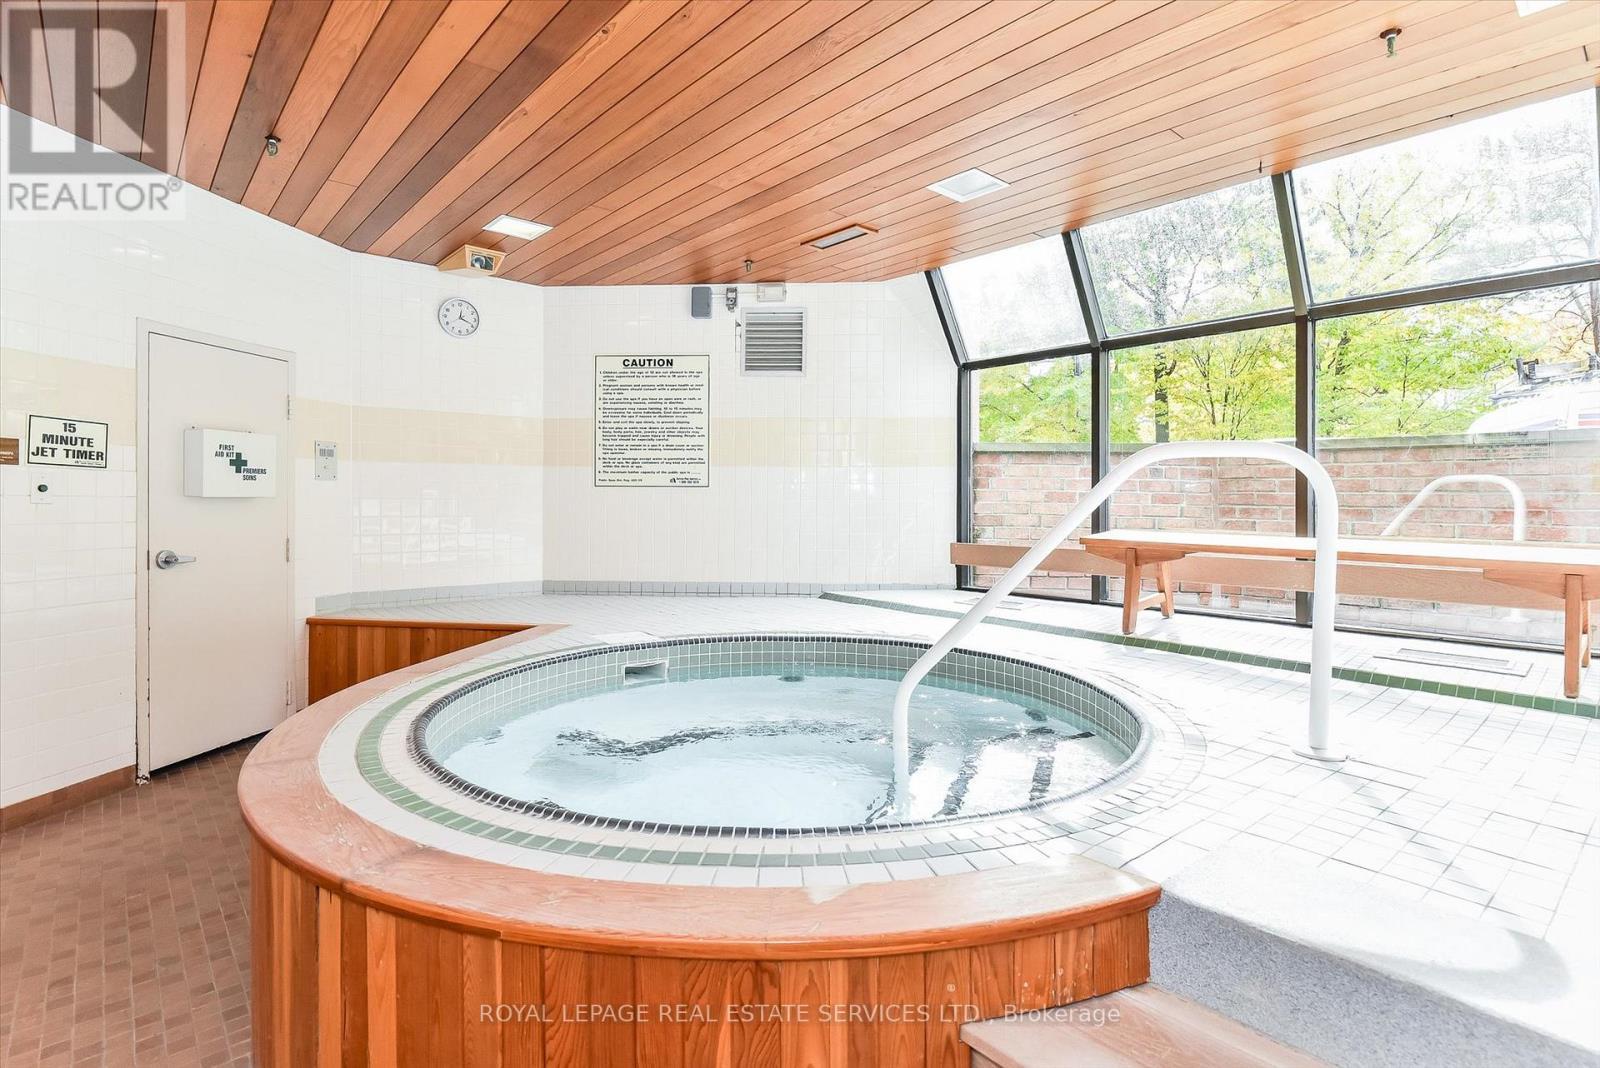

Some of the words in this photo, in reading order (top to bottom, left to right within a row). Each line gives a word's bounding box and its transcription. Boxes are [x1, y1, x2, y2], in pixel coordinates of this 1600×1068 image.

[622, 358, 674, 366] CAUTION
[62, 422, 77, 433] 15
[42, 433, 94, 448] MINUTE
[31, 446, 57, 458] JET
[63, 448, 104, 461] TIMER
